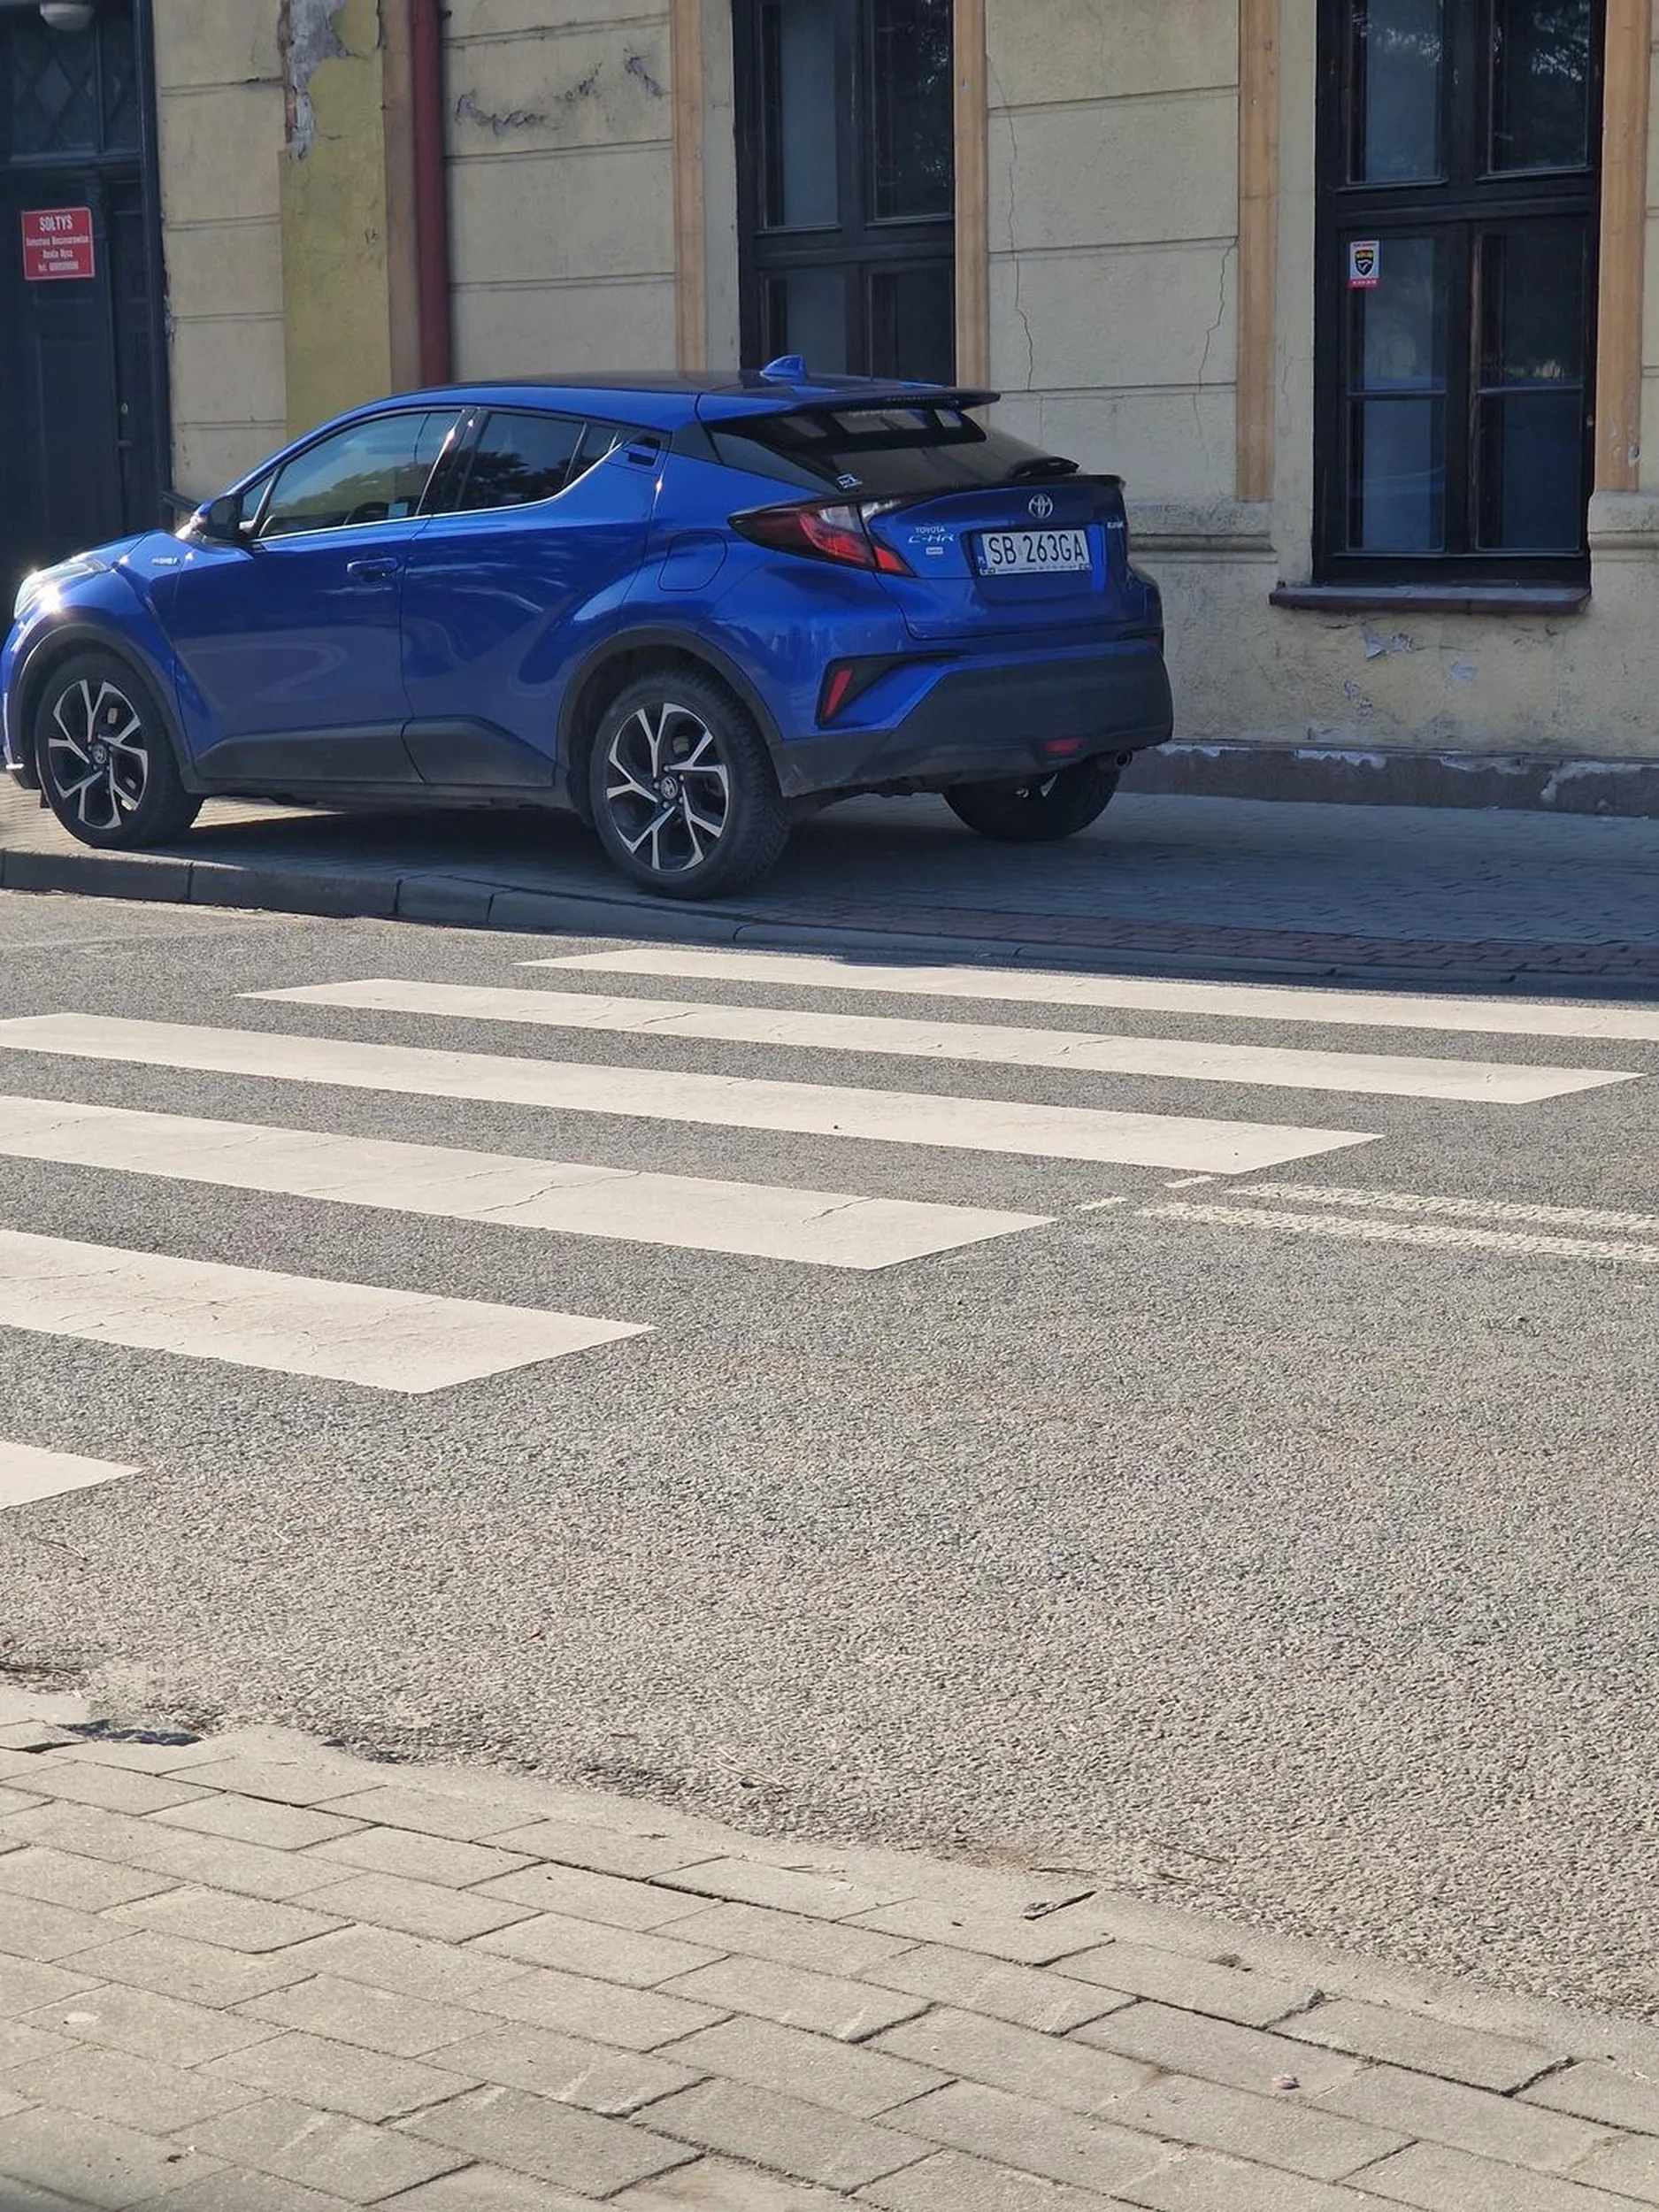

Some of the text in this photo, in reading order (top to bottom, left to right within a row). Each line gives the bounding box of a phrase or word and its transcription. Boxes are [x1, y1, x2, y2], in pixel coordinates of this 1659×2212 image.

[909, 534, 955, 544] C-HR
[988, 534, 1086, 565] SB 263GA
